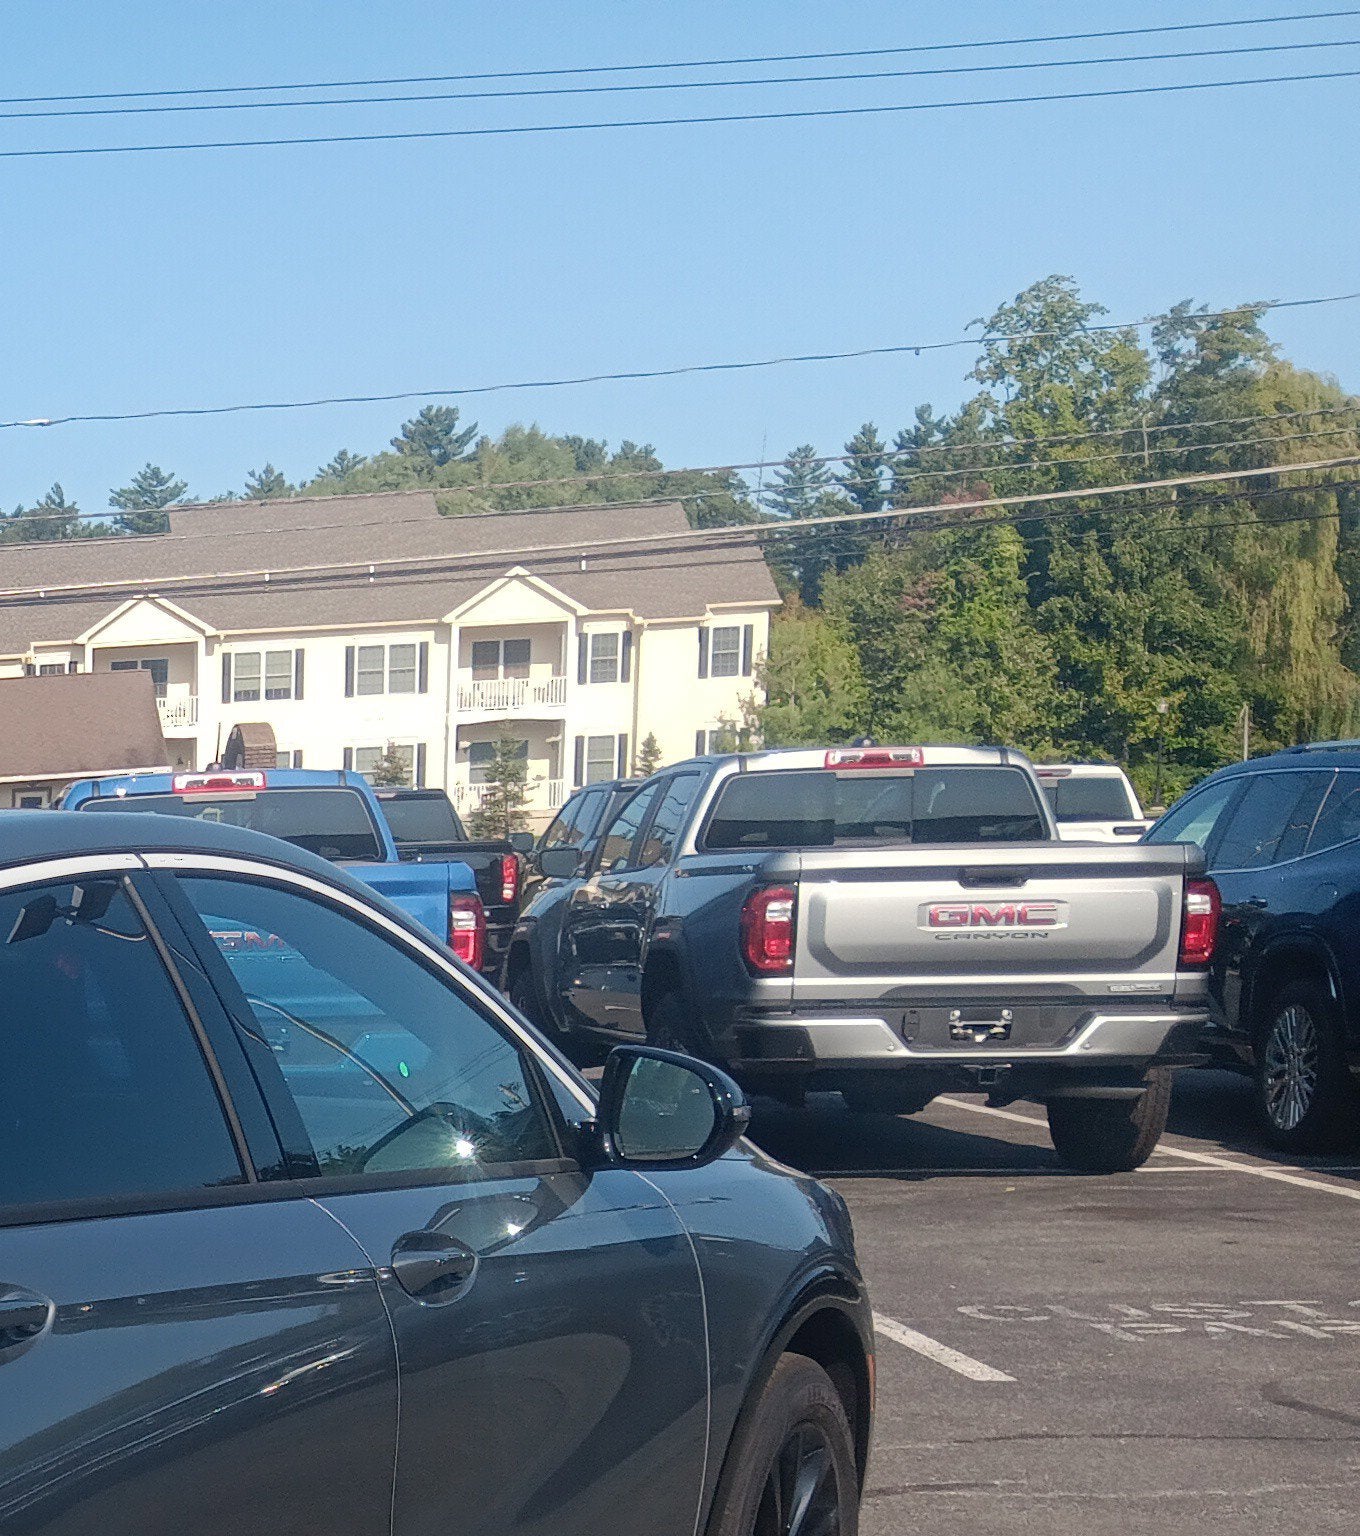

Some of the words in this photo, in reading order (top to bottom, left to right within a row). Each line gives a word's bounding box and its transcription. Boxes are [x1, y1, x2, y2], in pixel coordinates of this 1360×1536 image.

[929, 904, 1058, 926] GMC
[208, 931, 285, 951] GM
[934, 932, 1049, 941] CANYON
[956, 1300, 1360, 1322] CUST
